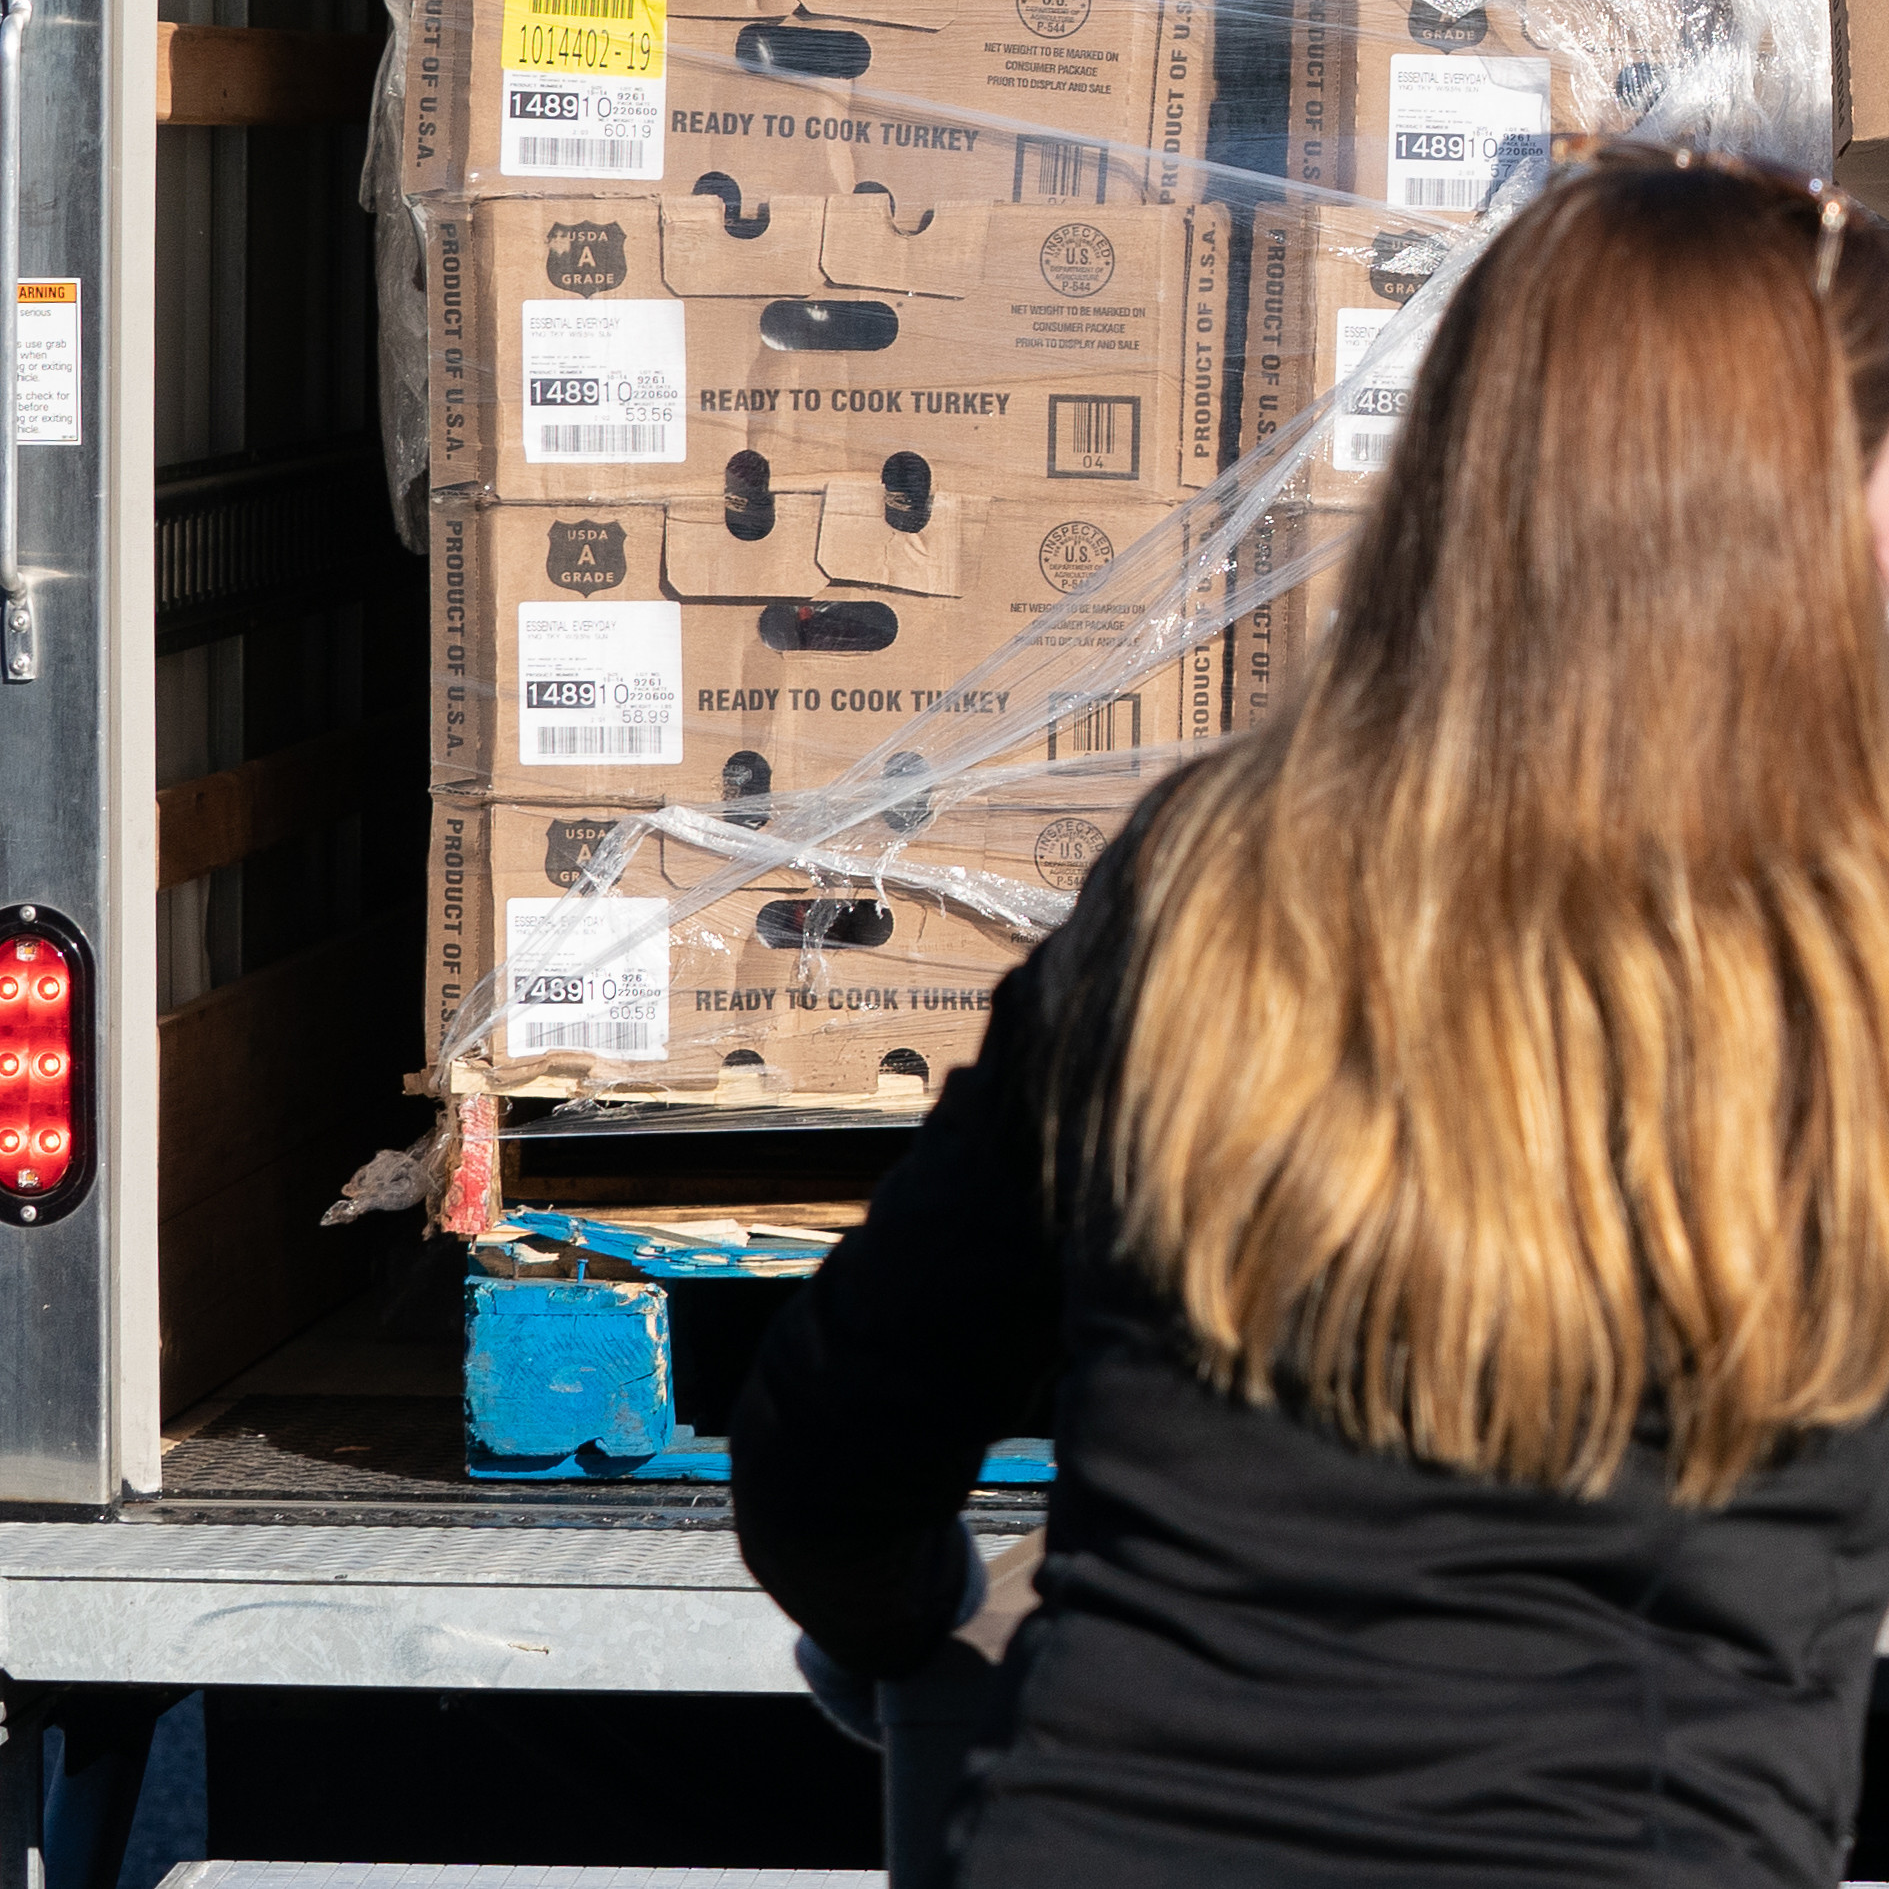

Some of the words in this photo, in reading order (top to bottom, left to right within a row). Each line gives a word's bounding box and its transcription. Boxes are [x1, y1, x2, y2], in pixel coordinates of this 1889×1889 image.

[519, 24, 651, 71] 1014402-19
[1398, 72, 1439, 83] ESSENTIAL
[1444, 73, 1488, 85] EVERYDAY
[604, 123, 651, 138] 60.19
[672, 111, 754, 135] READY
[763, 115, 794, 138] TO
[805, 117, 871, 143] COOK
[880, 123, 980, 151] TURKEY
[18, 286, 65, 299] ARNING
[20, 308, 51, 317] serious
[25, 341, 42, 349] use
[46, 339, 67, 351] grab
[21, 351, 47, 359] when
[42, 362, 72, 373] exiting
[26, 392, 53, 400] check
[57, 392, 70, 400] for
[701, 389, 780, 411] READY
[789, 389, 820, 411] TO
[832, 389, 901, 412] COOK
[911, 391, 1009, 414] TURKEY
[19, 403, 48, 411] before
[42, 414, 72, 424] exiting
[625, 407, 673, 422] 53.56
[698, 688, 780, 713] READY
[789, 688, 820, 713] TO
[830, 689, 902, 713] COOK
[910, 689, 1010, 714] TURKEY
[621, 709, 670, 725] 58.99
[695, 989, 778, 1012] READY
[787, 989, 820, 1012] TO
[828, 988, 900, 1012] COOK
[908, 989, 992, 1012] TURKE
[610, 1006, 657, 1021] 60.58
